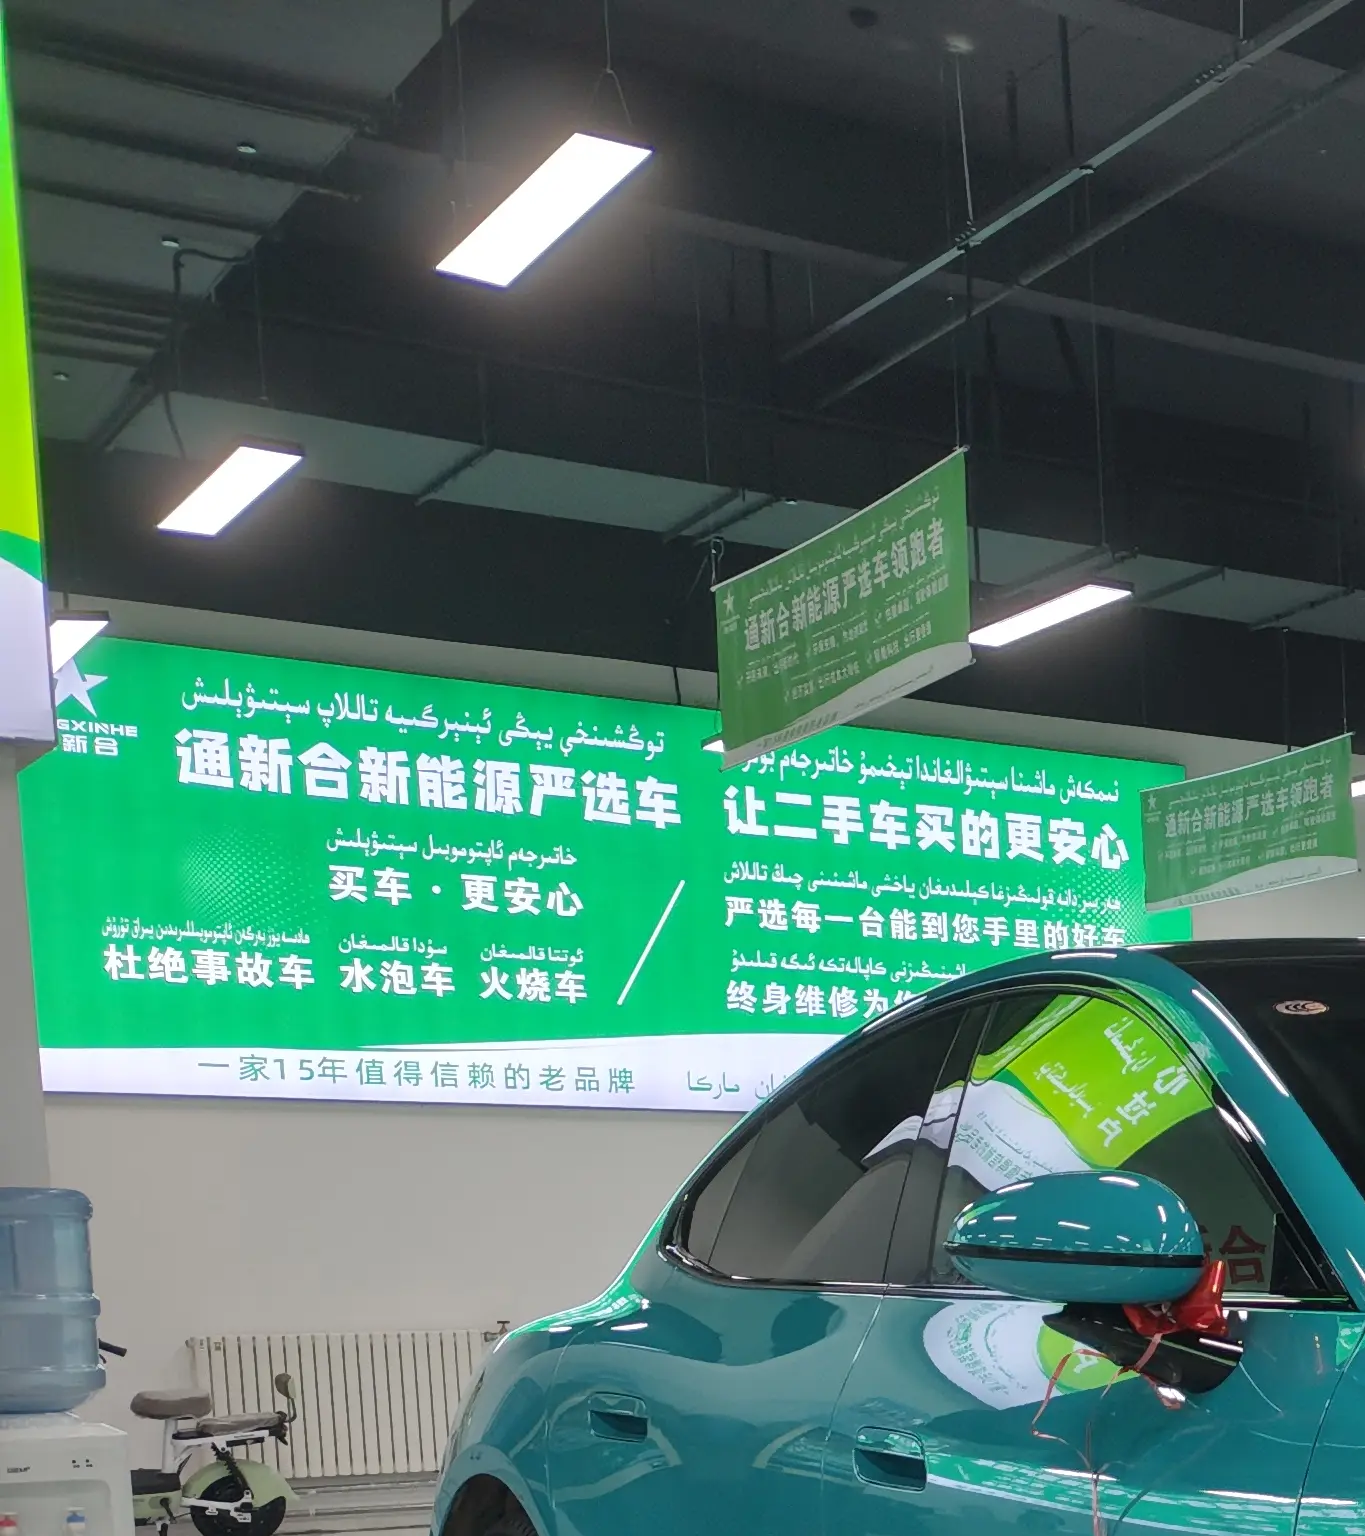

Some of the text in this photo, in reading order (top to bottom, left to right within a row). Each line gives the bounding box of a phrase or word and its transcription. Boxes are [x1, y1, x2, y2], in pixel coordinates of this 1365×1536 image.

[744, 517, 945, 651] 通新合新能源严选车领跑者
[181, 676, 310, 725] سېتىۋېلىش
[317, 692, 378, 728] تاللاپ
[385, 704, 492, 745] ئېنېرگىيە
[499, 711, 553, 751] يېڭى
[174, 728, 682, 829] 通新合新能源严选车
[780, 746, 854, 781] خاتىرجەم
[327, 827, 577, 871] خاتىرجەم ئاپتوموبىل سېتىۋېلىش
[724, 785, 1130, 870] 让二手车买的更安心
[725, 896, 1126, 949] 严选每一台能到您手里的好车
[104, 943, 588, 1005] 杜绝事故车 水泡车 火烧车
[198, 1054, 636, 1096] 一家15年值得信赖的老品牌
[687, 1071, 740, 1100] ماركا
